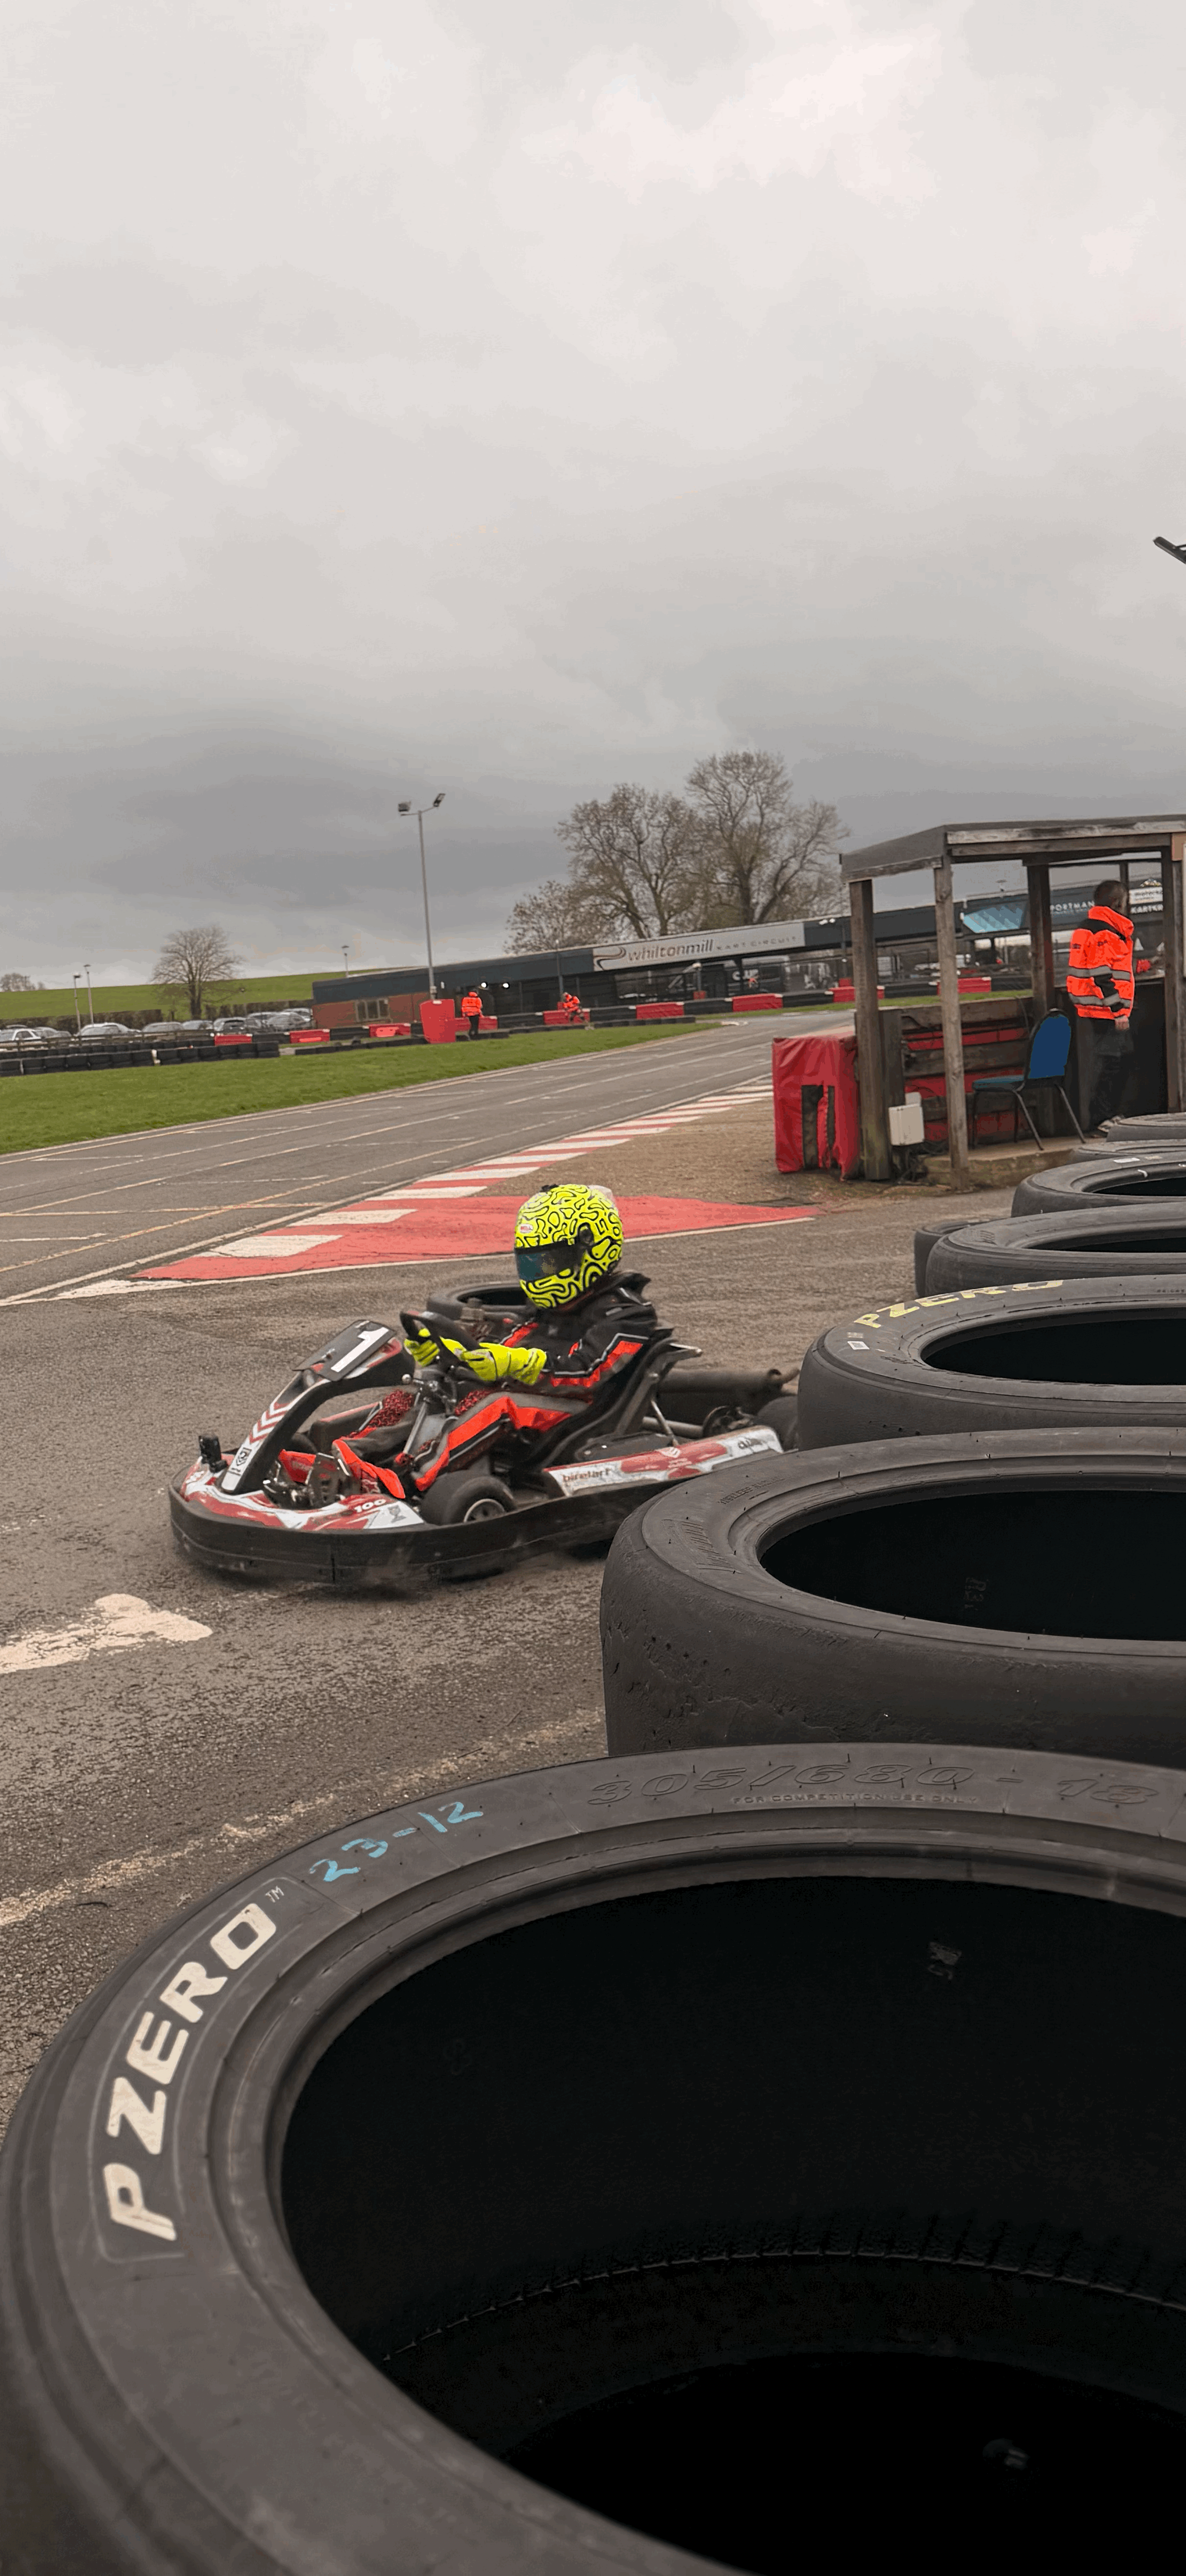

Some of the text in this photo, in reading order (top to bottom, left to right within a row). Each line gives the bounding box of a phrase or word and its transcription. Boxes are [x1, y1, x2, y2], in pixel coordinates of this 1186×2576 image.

[330, 1327, 389, 1372] 1
[354, 1499, 386, 1513] 100
[588, 1765, 975, 1805] 305/680
[1058, 1778, 1159, 1804] 18
[733, 1793, 977, 1805] FOR COMPETITION USE ONLY
[309, 1801, 483, 1882] 23-12
[103, 1903, 277, 2241] PZERO
